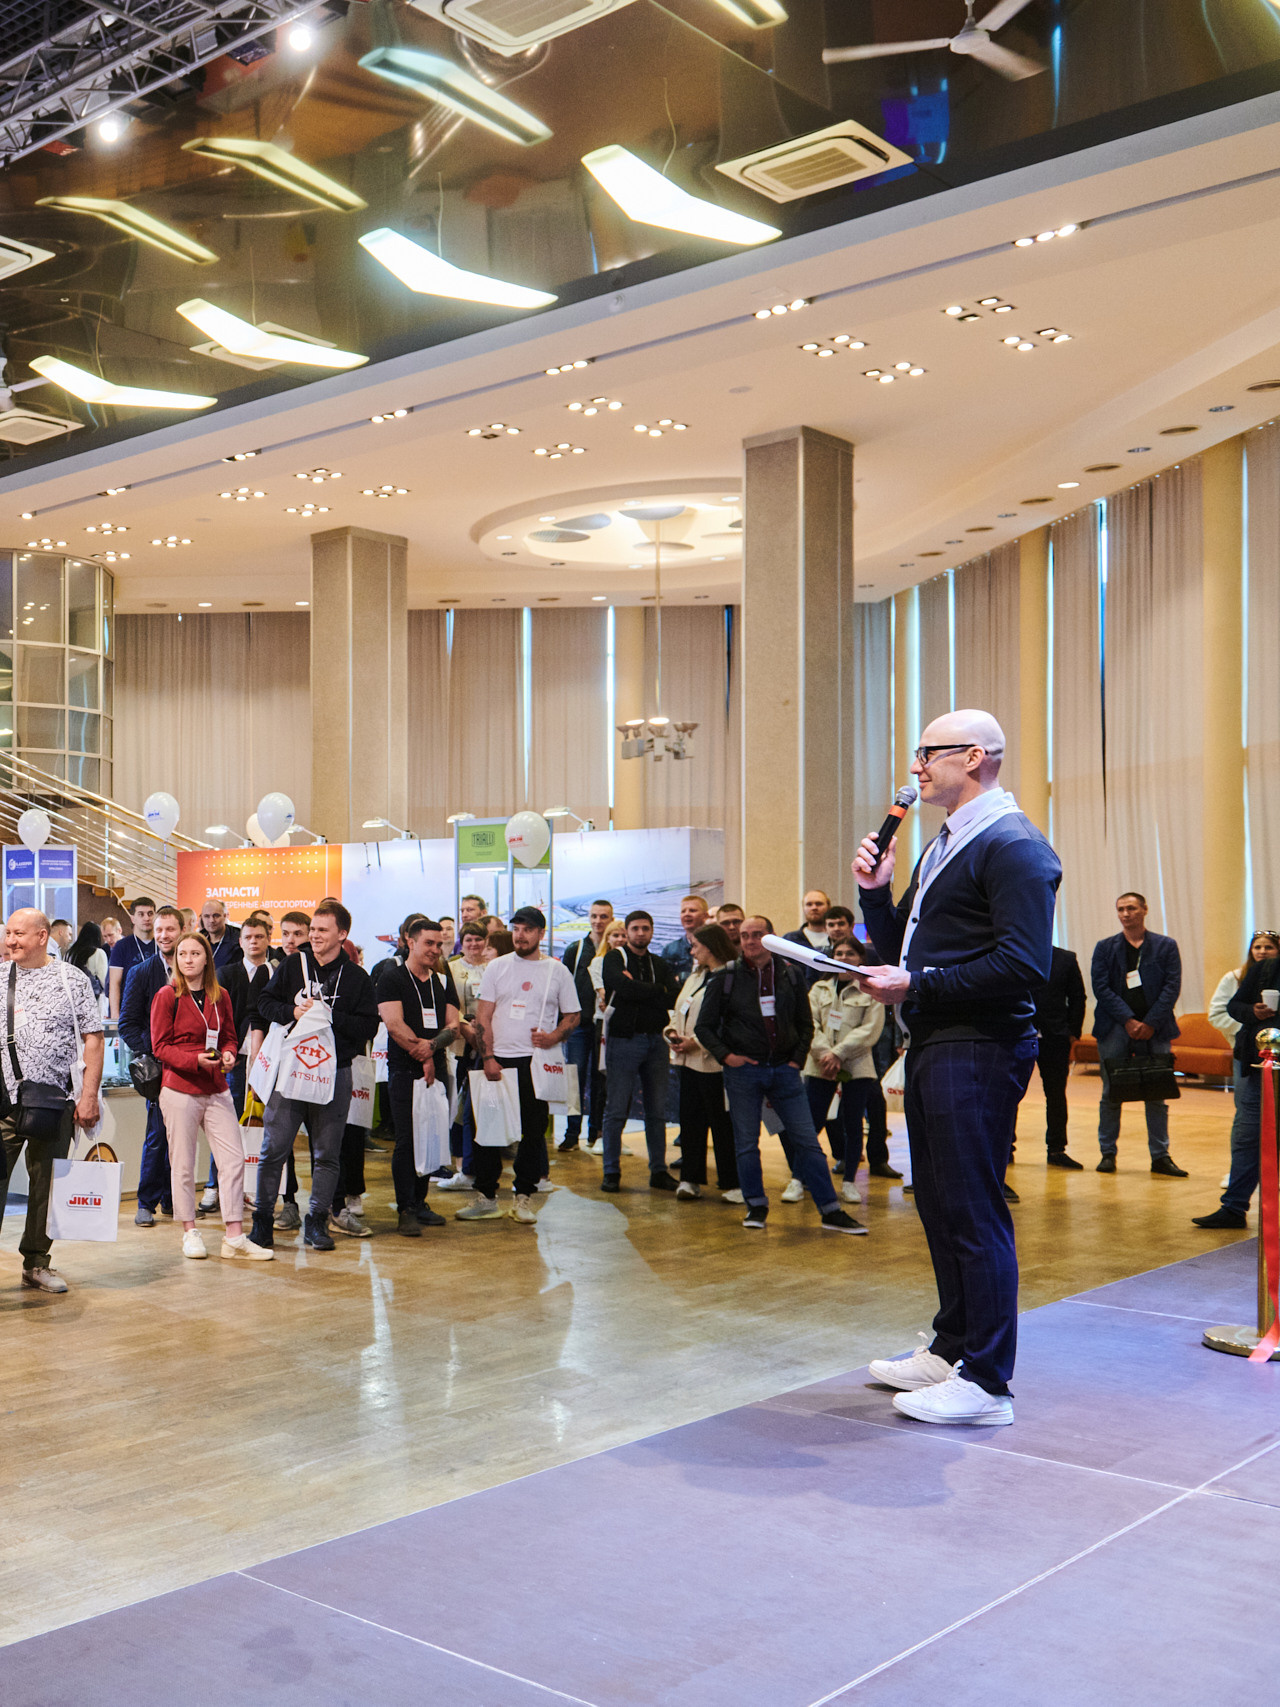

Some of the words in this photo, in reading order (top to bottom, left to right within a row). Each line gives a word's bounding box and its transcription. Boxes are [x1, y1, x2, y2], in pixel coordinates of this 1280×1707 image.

[206, 886, 260, 898] ЗАПЧАСТИ
[260, 900, 316, 909] АВТОСПОРТОМ
[68, 1196, 102, 1206] JIKIU
